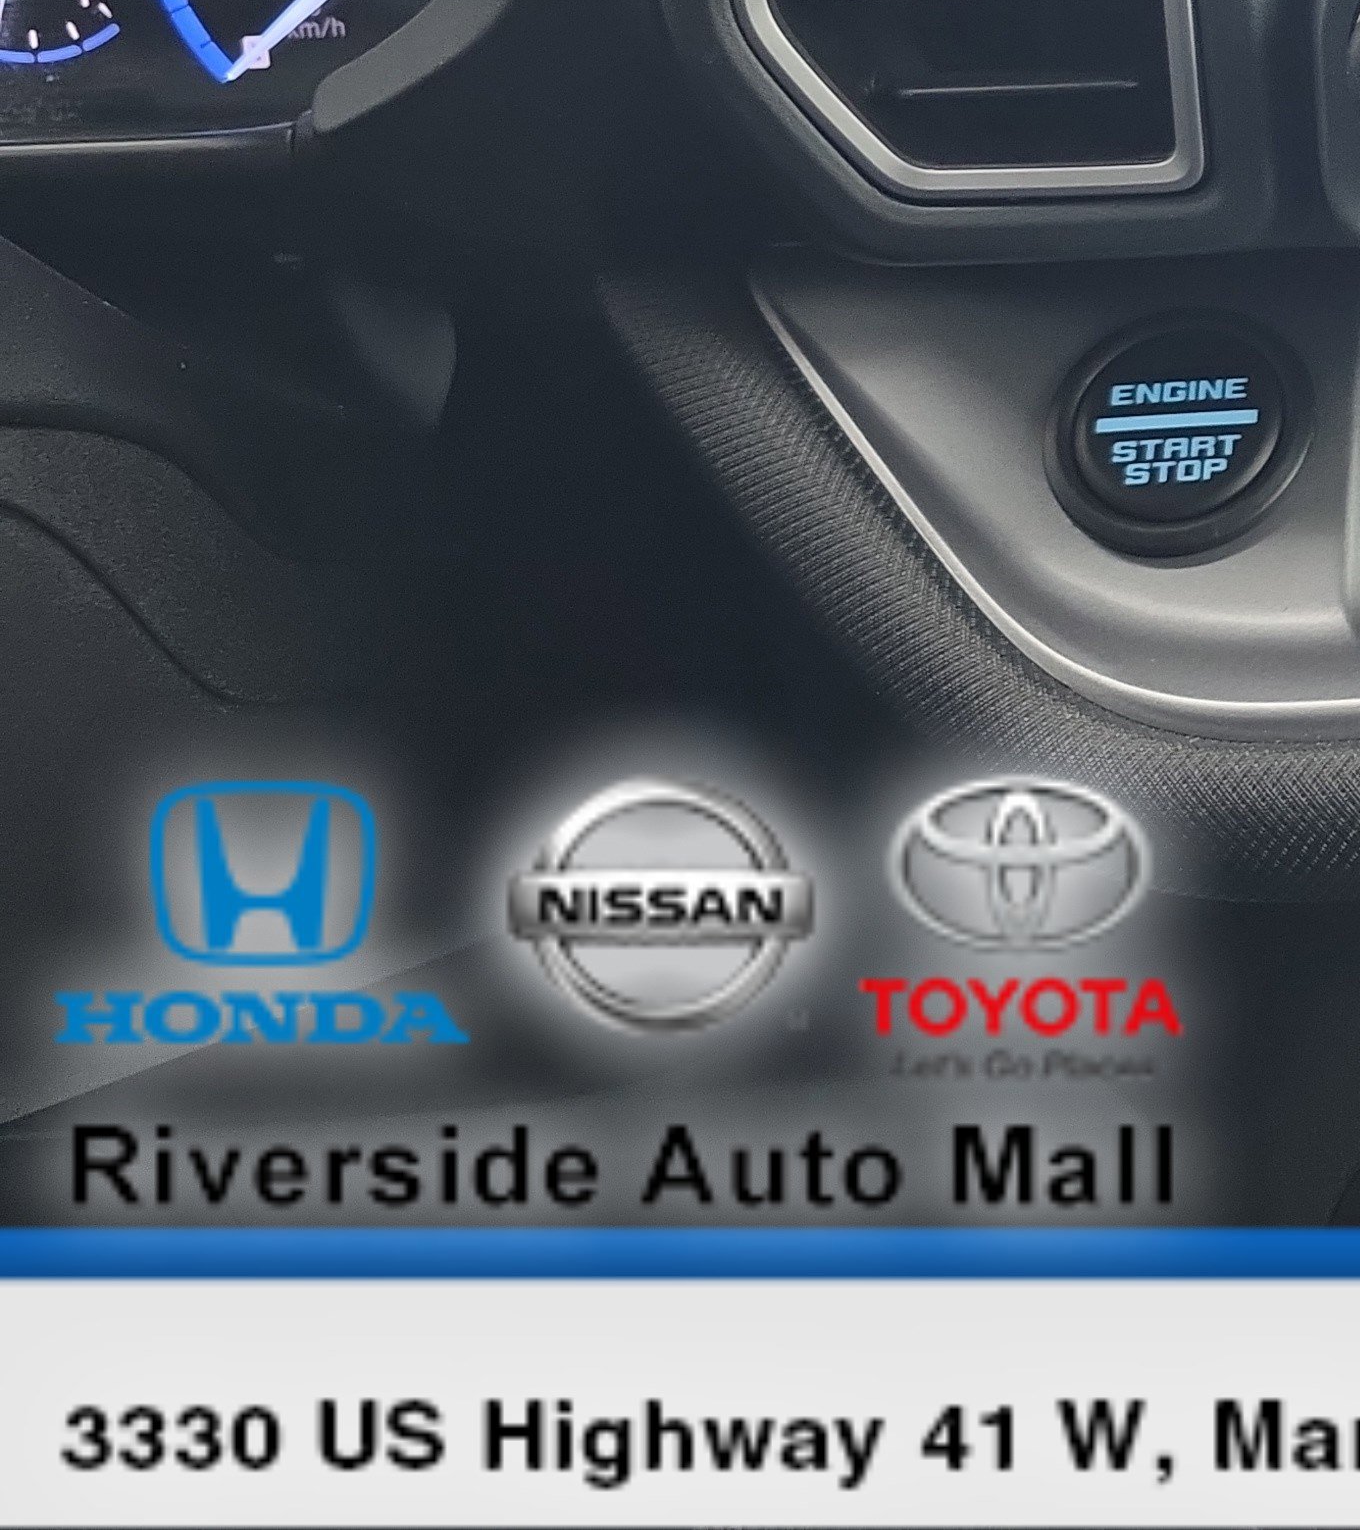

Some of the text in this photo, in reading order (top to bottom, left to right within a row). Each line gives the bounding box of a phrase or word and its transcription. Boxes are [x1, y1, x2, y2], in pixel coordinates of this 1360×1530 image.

[1111, 377, 1249, 407] ENGINE
[1112, 434, 1243, 463] START
[1124, 458, 1228, 486] STOP
